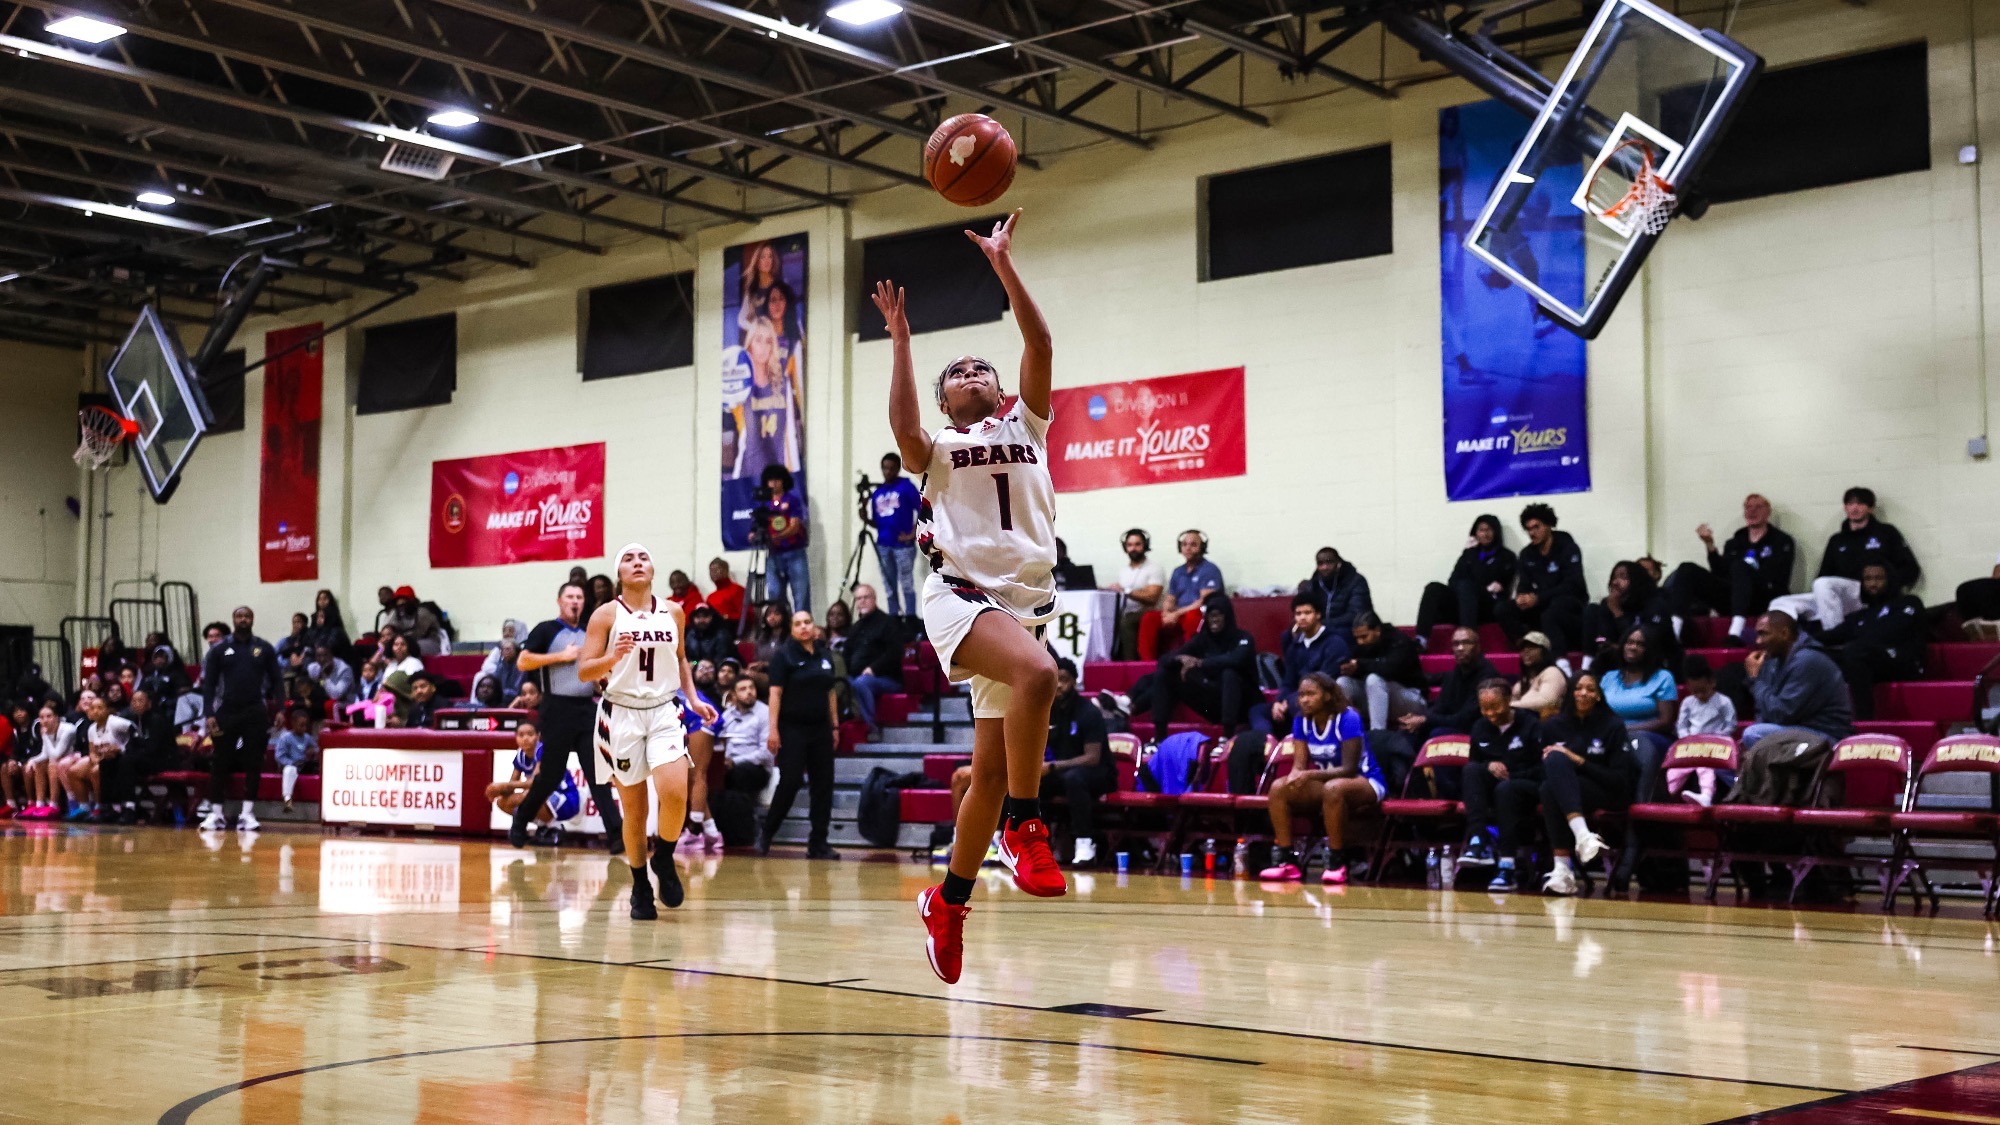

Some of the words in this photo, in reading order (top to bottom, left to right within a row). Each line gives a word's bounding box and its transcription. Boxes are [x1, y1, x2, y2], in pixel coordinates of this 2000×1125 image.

[1064, 439, 1115, 461] MAKE
[1118, 437, 1136, 457] IT
[1136, 418, 1211, 465] YOURS
[1456, 437, 1494, 453] MAKE
[1496, 435, 1511, 449] IT
[1510, 424, 1567, 455] YOURS
[950, 444, 1038, 470] BEARS
[486, 511, 523, 530] MAKE
[524, 509, 539, 527] IT
[538, 494, 592, 535] YOURS
[991, 473, 1013, 531] 1
[619, 631, 673, 643] EARS
[639, 647, 655, 681] 4
[345, 764, 443, 782] BLOOMFIELD
[332, 789, 399, 808] COLLEGE
[403, 791, 457, 810] BEARS
